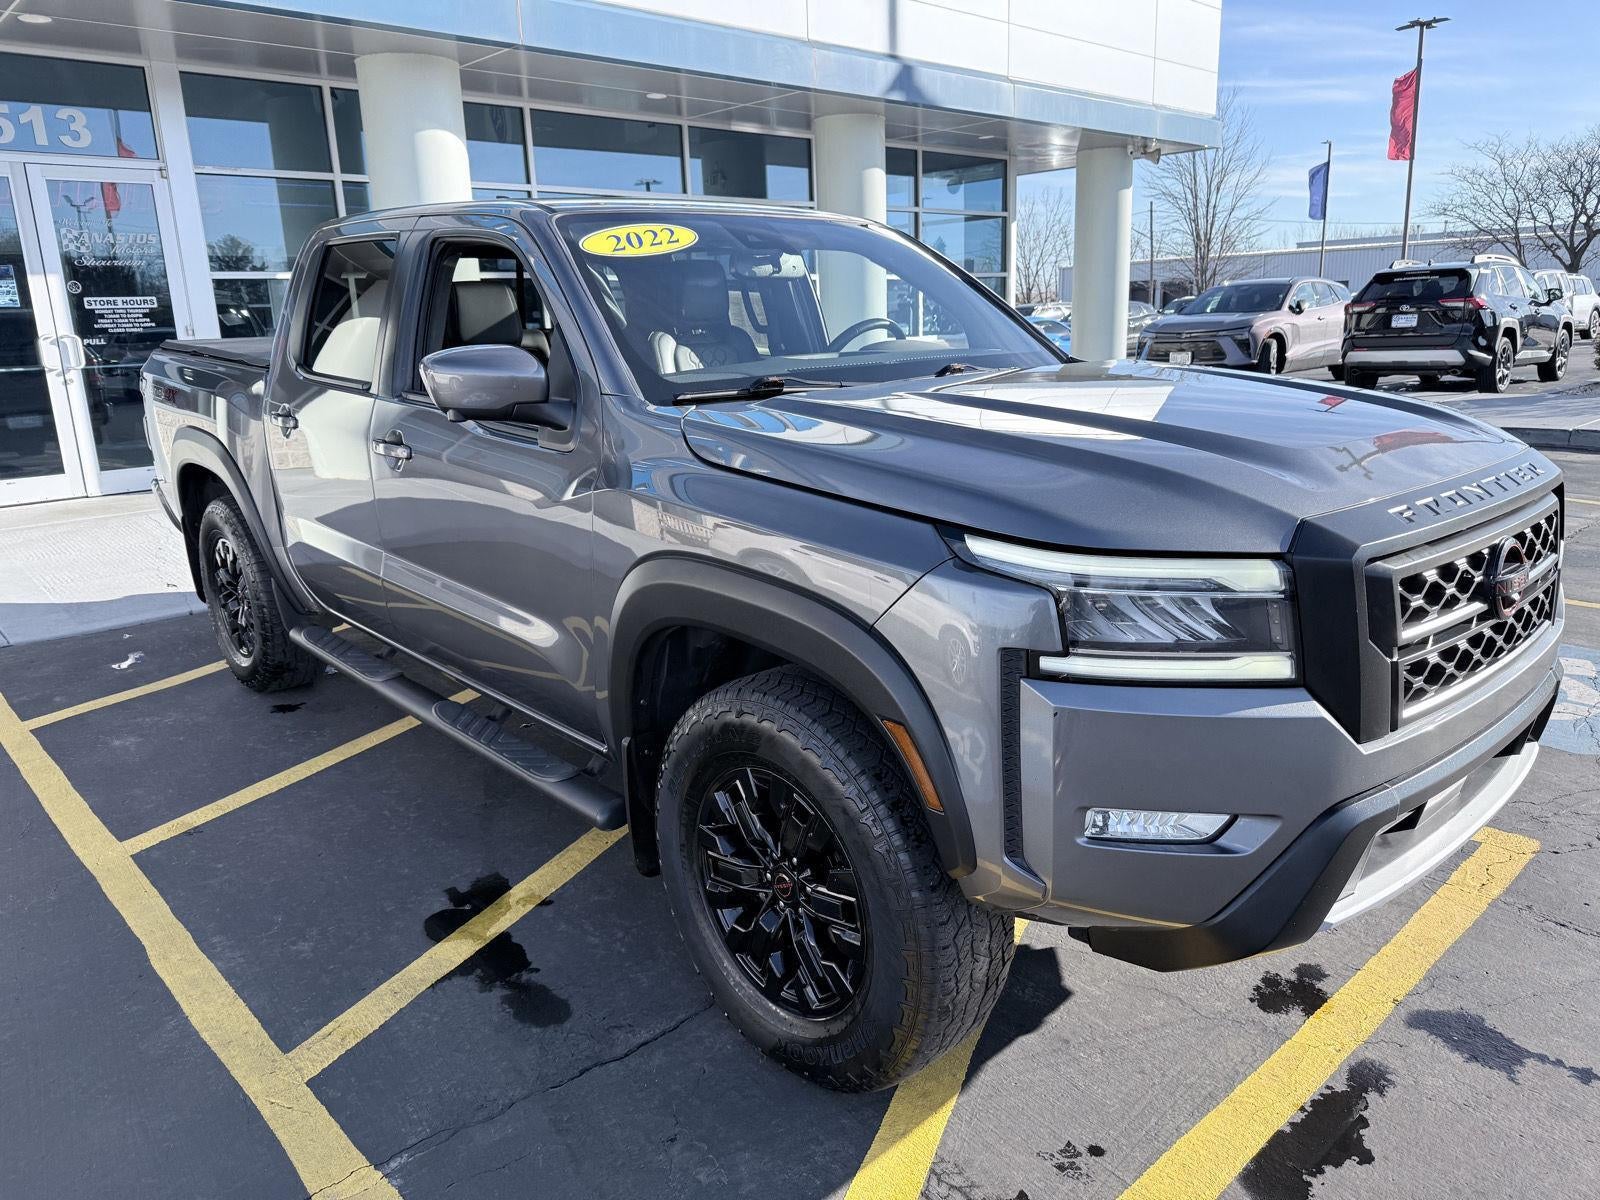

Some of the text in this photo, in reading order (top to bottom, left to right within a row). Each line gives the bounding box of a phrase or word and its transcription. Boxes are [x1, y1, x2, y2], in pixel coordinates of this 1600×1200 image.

[606, 227, 680, 252] 2022
[74, 255, 146, 267] Showroom
[86, 298, 155, 307] STORE HOURS
[83, 338, 107, 346] PULL
[1387, 462, 1546, 526] FRONTIER
